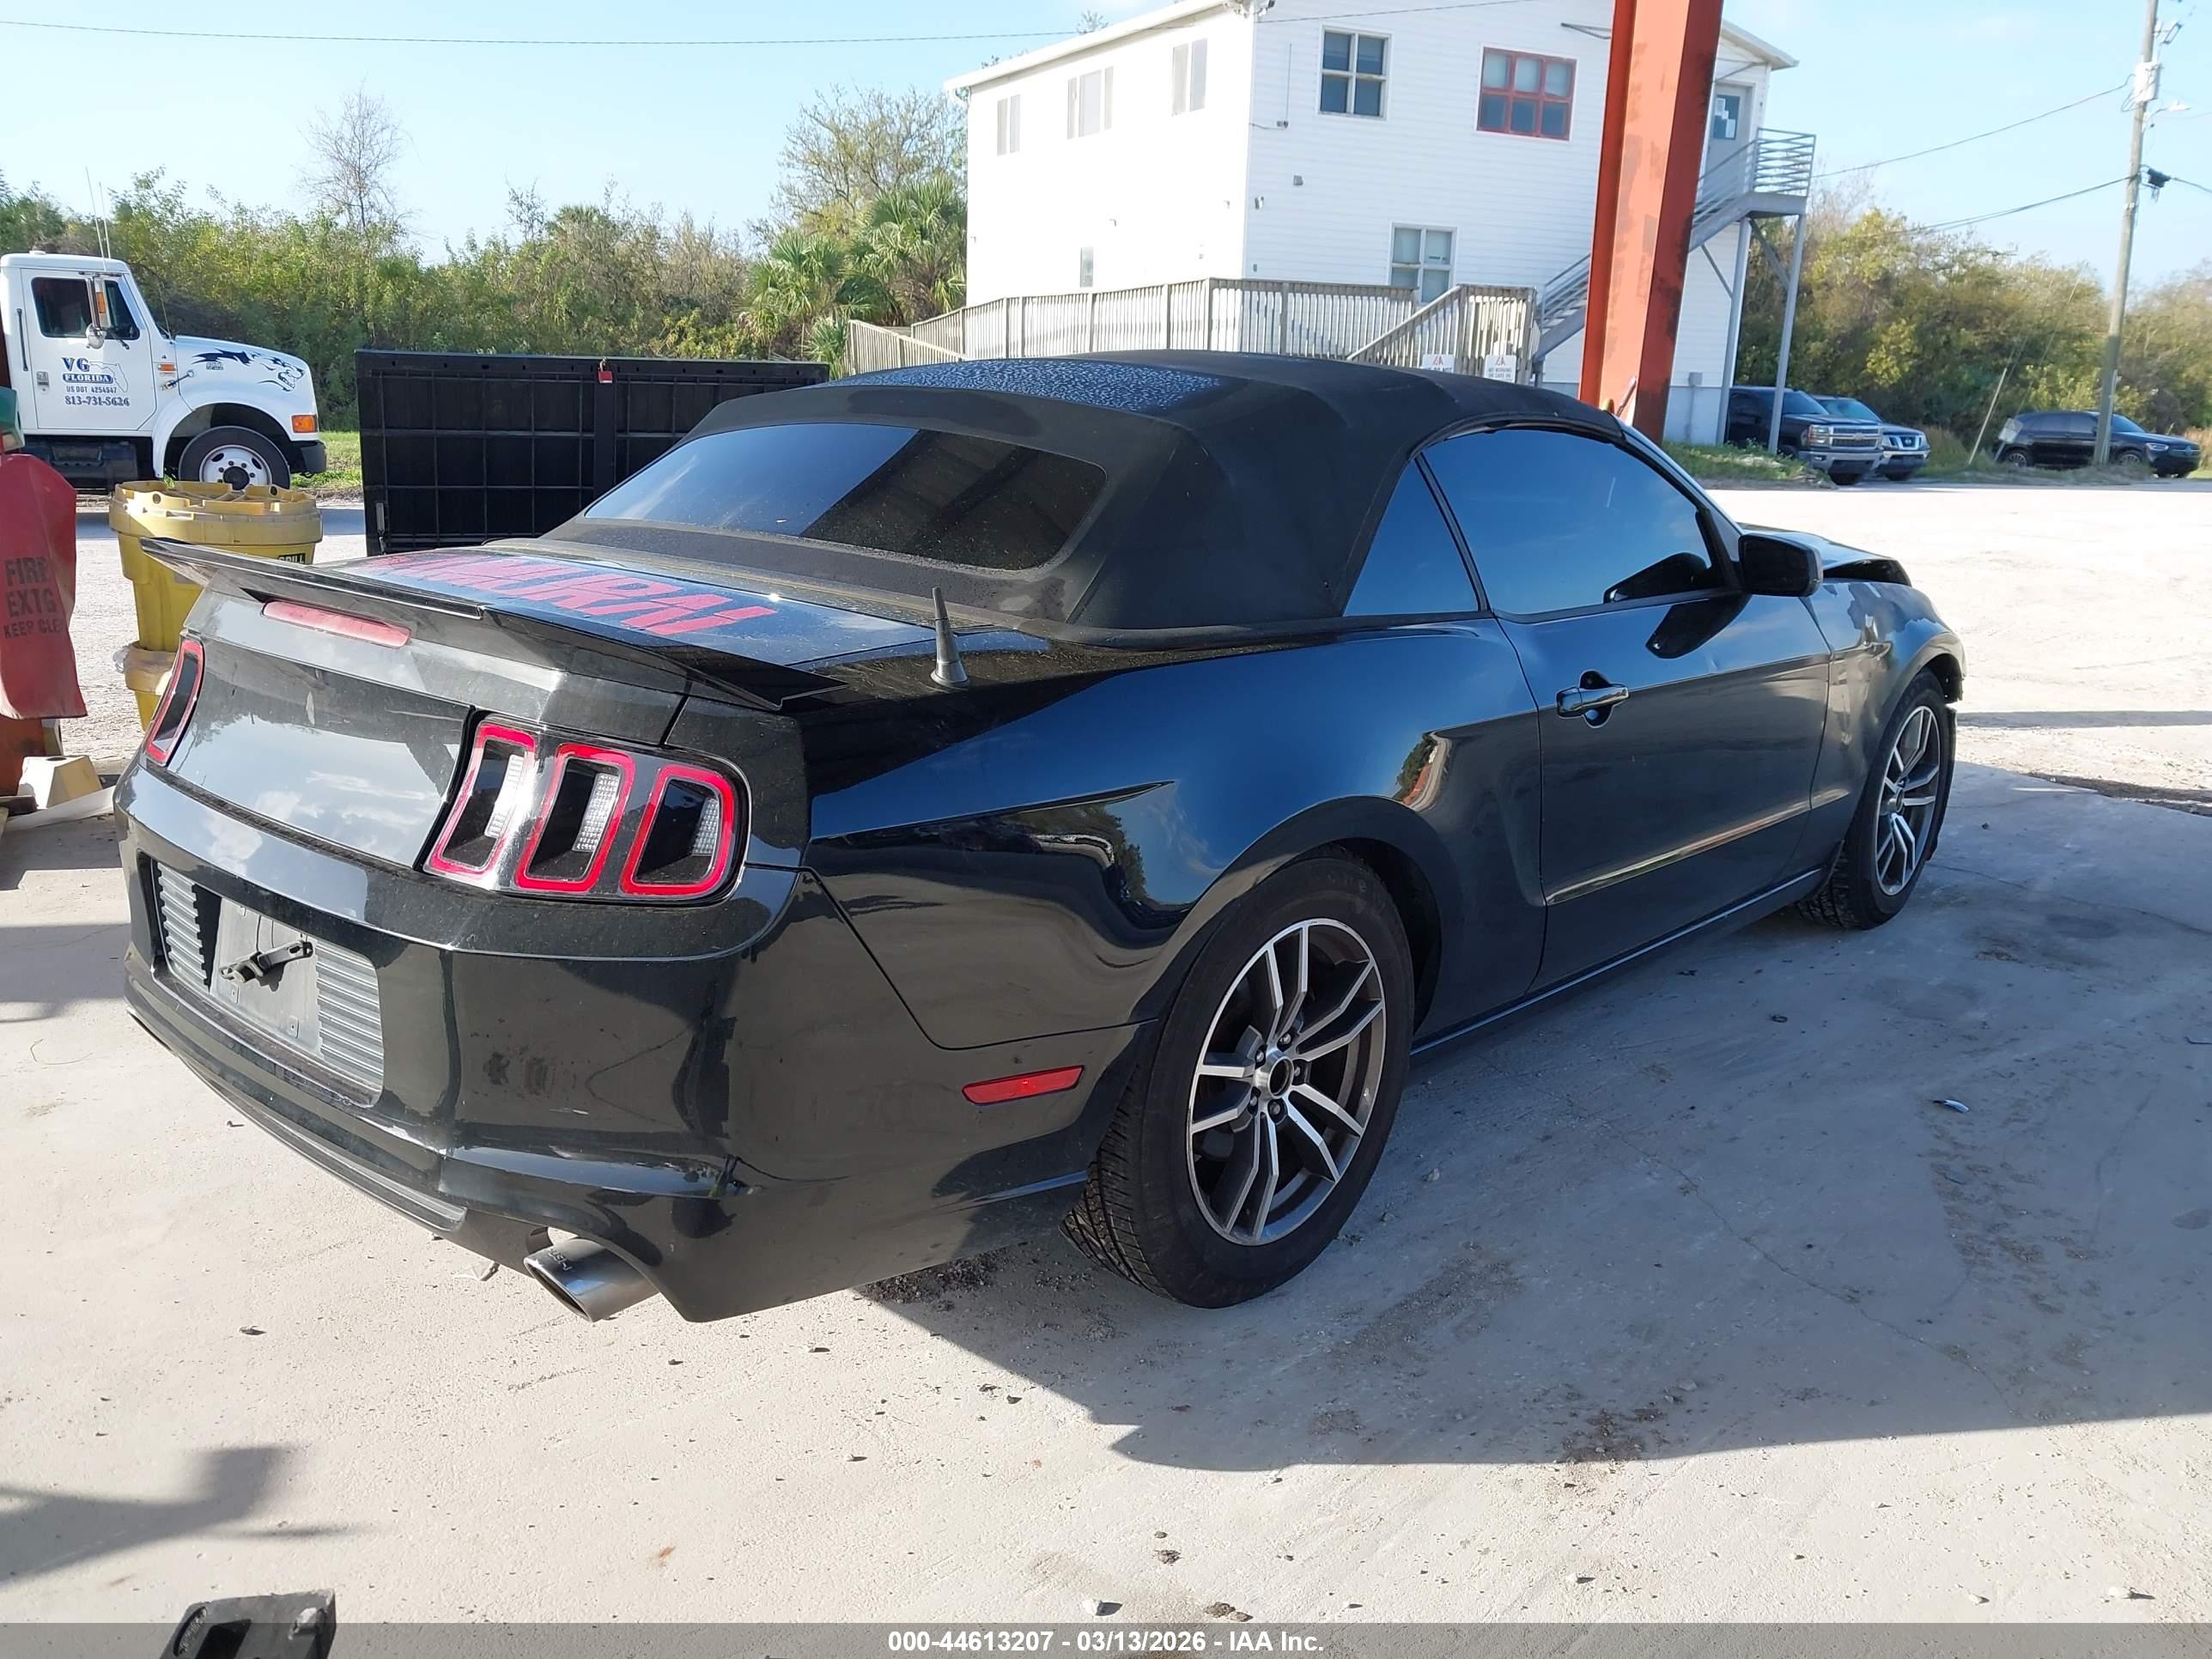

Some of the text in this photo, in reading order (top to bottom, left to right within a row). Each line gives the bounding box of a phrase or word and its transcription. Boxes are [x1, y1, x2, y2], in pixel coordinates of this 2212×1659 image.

[62, 357, 90, 372] VG
[64, 374, 110, 383] FLORIDA
[65, 395, 131, 406] 813-731-5626
[3, 619, 33, 639] KEEP
